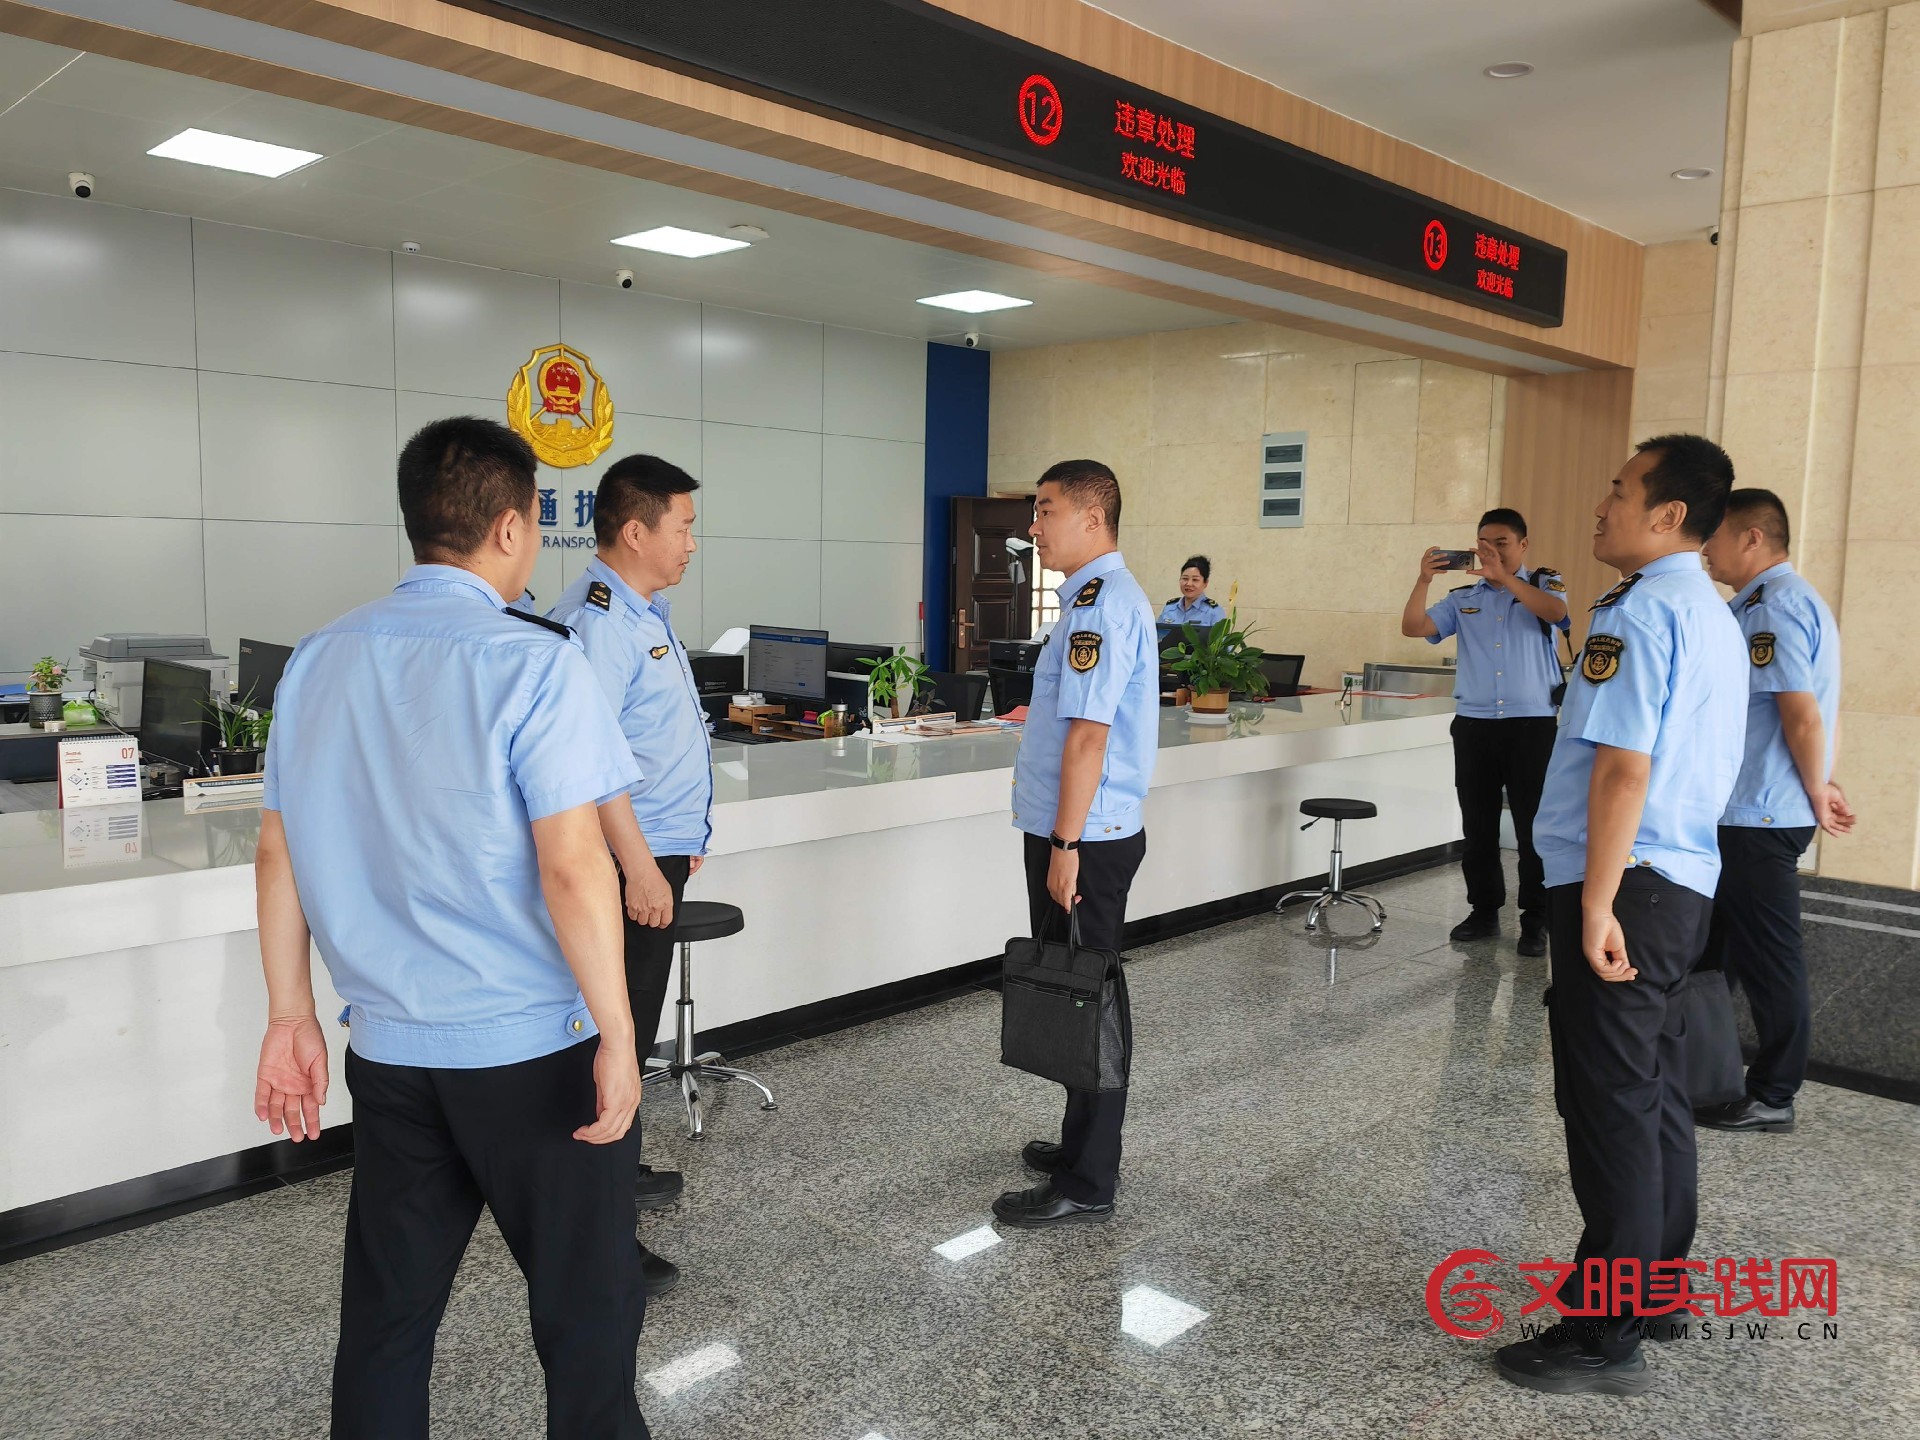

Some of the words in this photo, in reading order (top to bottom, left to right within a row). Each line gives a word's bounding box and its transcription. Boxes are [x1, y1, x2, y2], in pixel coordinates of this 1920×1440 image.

[1114, 99, 1196, 159] 违章处理
[1121, 150, 1186, 195] 欢迎光临
[1475, 232, 1520, 271] 违章处理
[1476, 269, 1514, 299] 欢迎光临
[541, 535, 596, 548] RANSPO
[121, 747, 134, 760] 07
